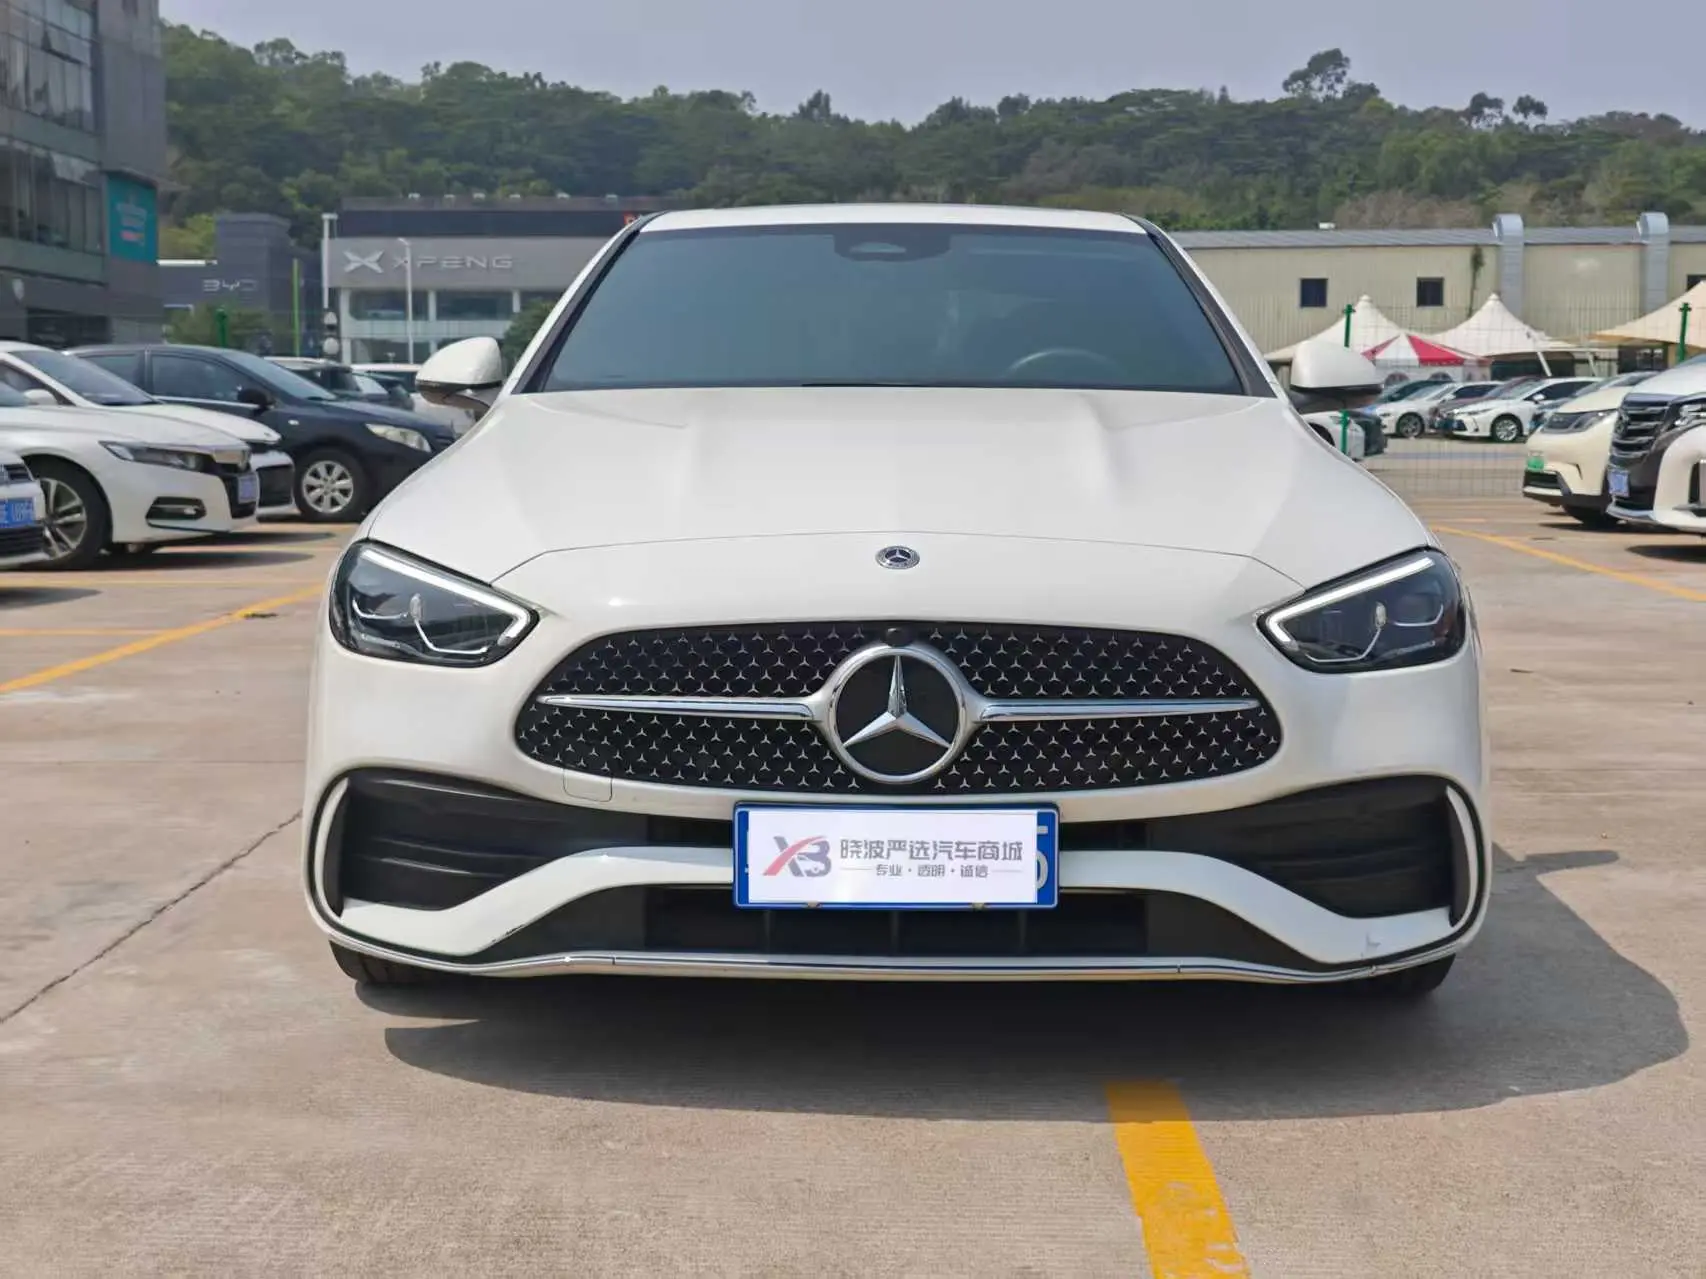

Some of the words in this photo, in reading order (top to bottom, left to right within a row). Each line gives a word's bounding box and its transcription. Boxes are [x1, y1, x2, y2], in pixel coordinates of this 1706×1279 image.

[393, 255, 513, 269] XPENG
[839, 839, 1023, 861] 晓波严选汽车商城
